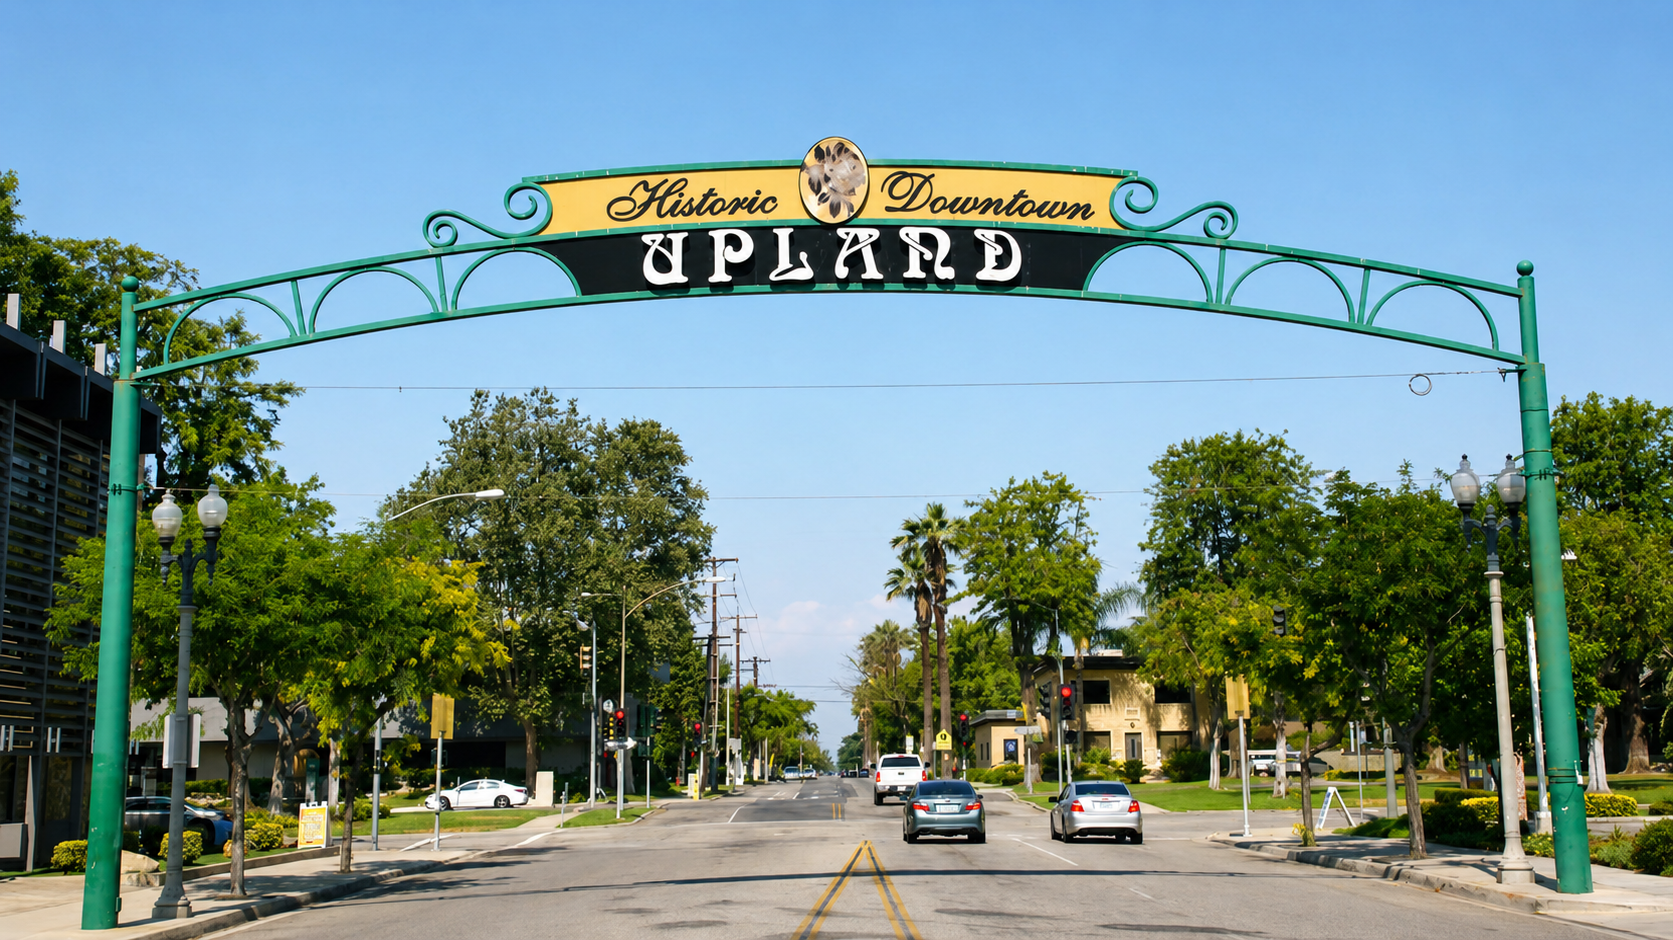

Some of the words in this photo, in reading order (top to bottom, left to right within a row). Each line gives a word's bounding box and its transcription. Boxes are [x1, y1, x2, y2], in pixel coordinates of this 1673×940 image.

[606, 177, 778, 222] Historic
[880, 170, 1095, 220] Downtown
[641, 226, 1022, 285] UPLAND
